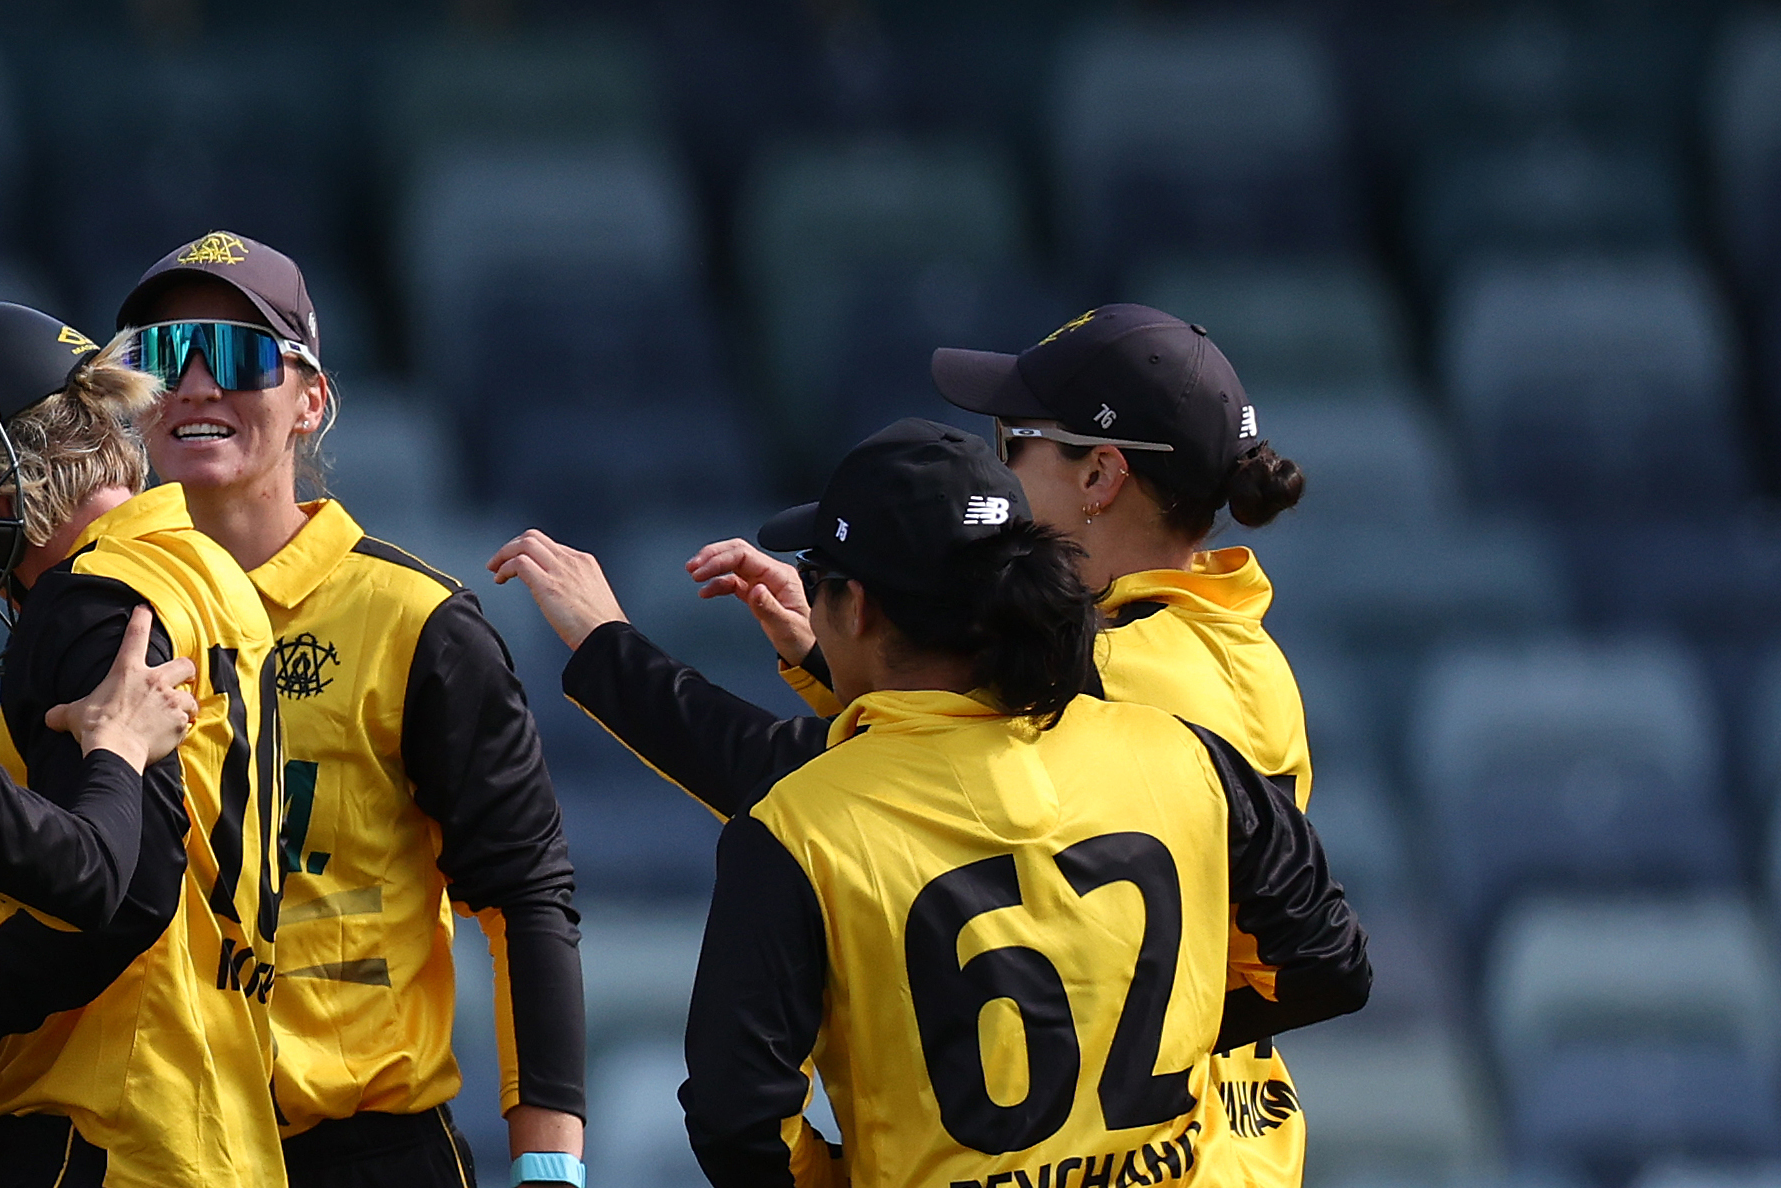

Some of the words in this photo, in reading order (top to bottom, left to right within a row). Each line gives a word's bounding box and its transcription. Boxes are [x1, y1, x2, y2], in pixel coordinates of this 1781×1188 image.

[1092, 402, 1117, 430] 76
[835, 517, 850, 543] 75
[905, 830, 1197, 1155] 62
